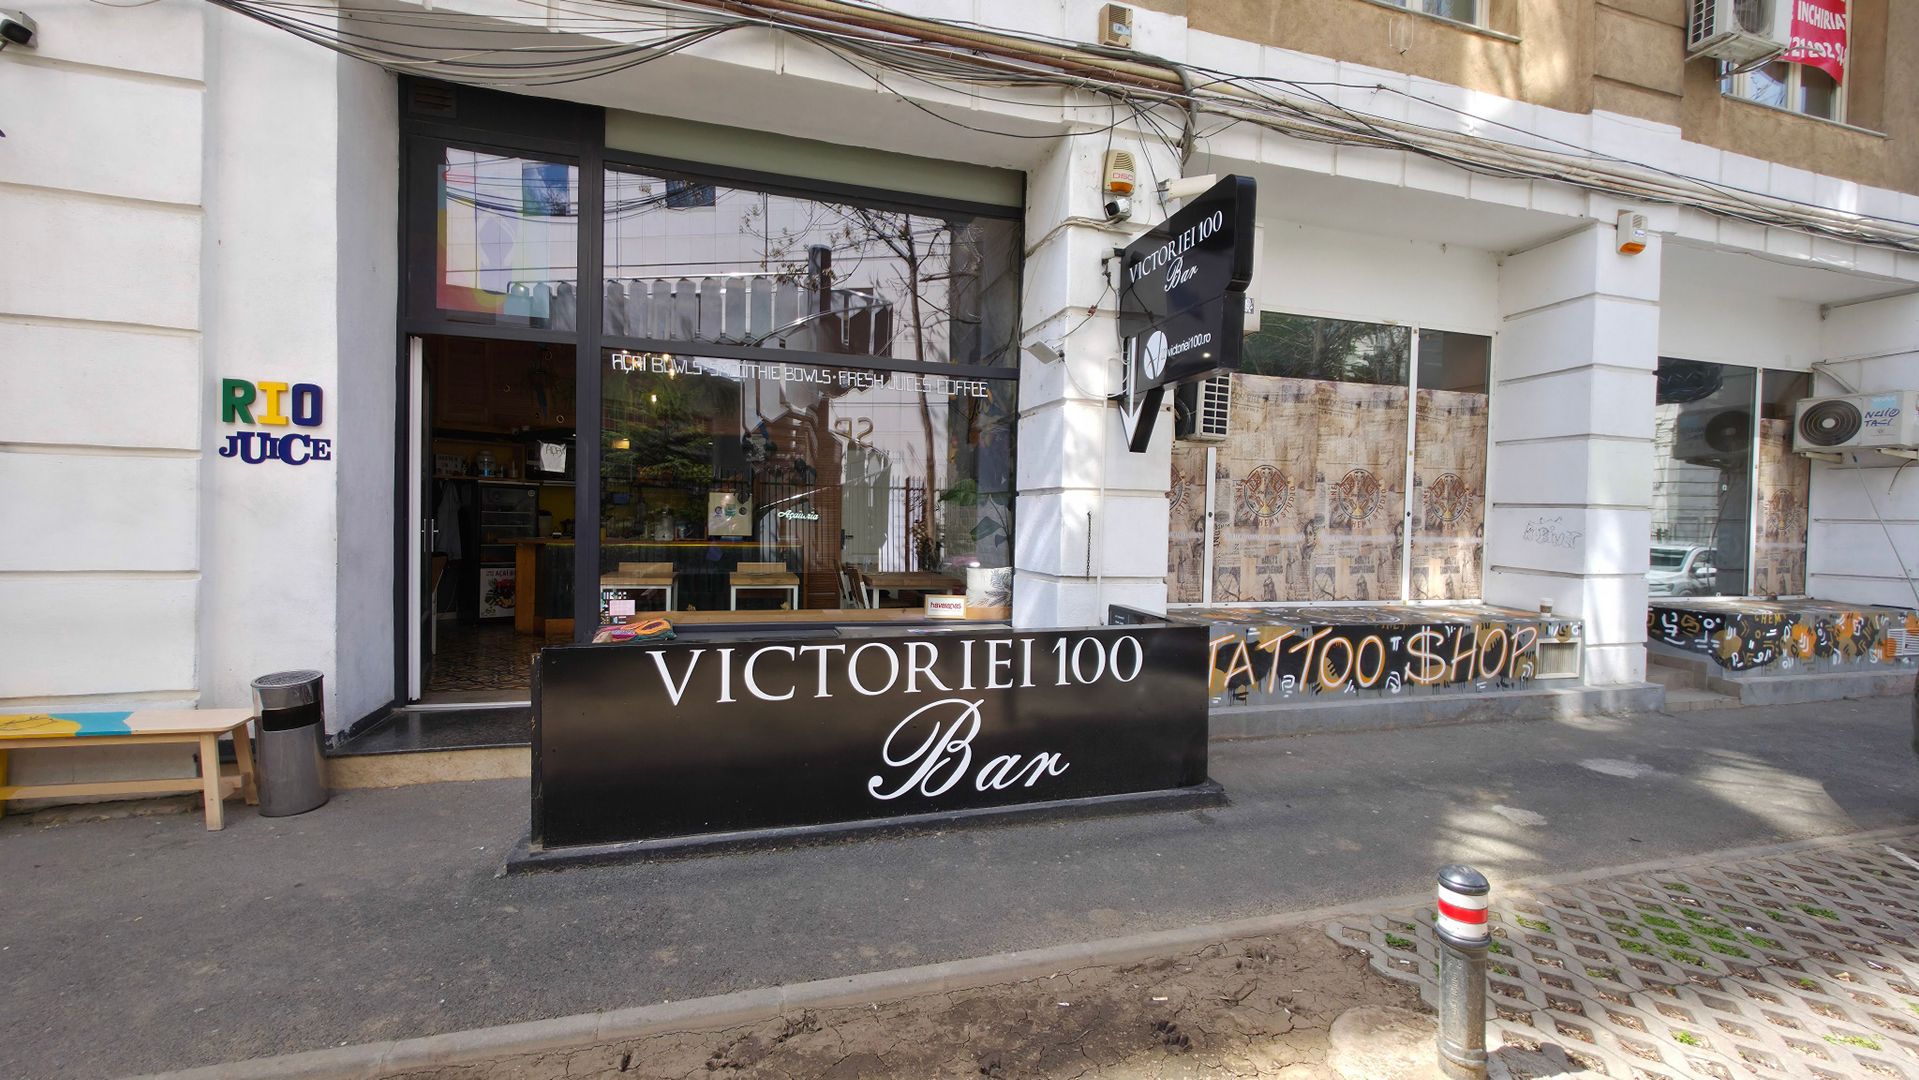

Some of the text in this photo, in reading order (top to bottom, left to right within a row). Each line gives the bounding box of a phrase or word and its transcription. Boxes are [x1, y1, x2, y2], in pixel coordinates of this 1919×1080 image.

[1785, 36, 1805, 58] 21
[1129, 210, 1223, 283] VICTORIEI 100
[1164, 256, 1199, 292] Bar
[222, 378, 324, 426] RIO
[784, 367, 831, 384] BOWLS
[838, 371, 884, 389] FRESH
[937, 380, 989, 398] COFFEE
[219, 431, 331, 465] JUICE
[646, 635, 1143, 705] VICTORIEI 100
[1208, 627, 1384, 694] TATTOO
[868, 698, 1069, 800] Bar
